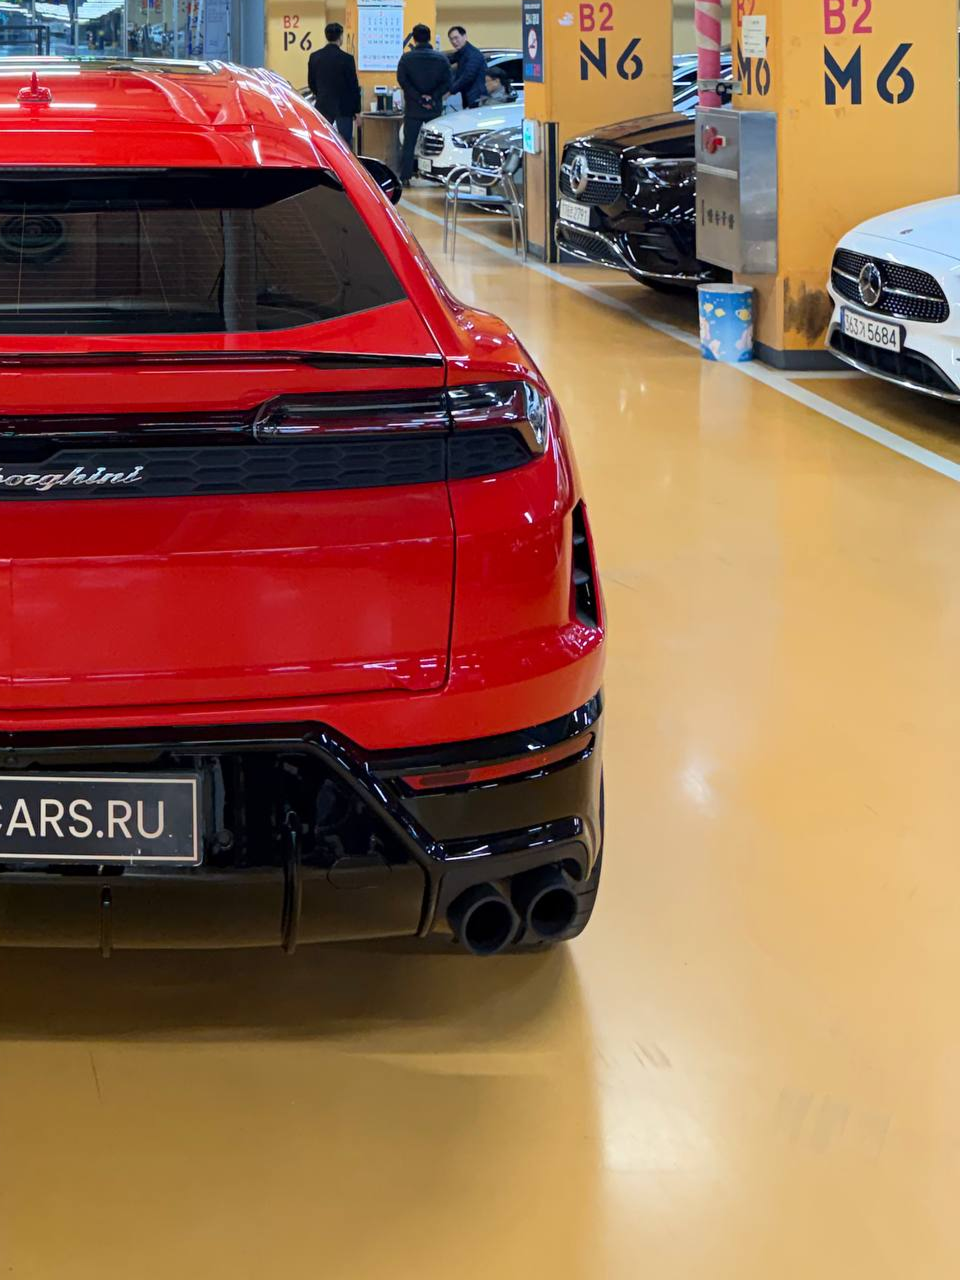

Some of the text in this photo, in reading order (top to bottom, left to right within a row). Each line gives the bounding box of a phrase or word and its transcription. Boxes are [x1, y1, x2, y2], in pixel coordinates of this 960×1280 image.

[283, 15, 300, 29] B2
[579, 2, 614, 32] B2
[284, 31, 312, 51] P6
[580, 37, 644, 81] N6
[824, 43, 915, 105] M6
[868, 323, 896, 348] 5684
